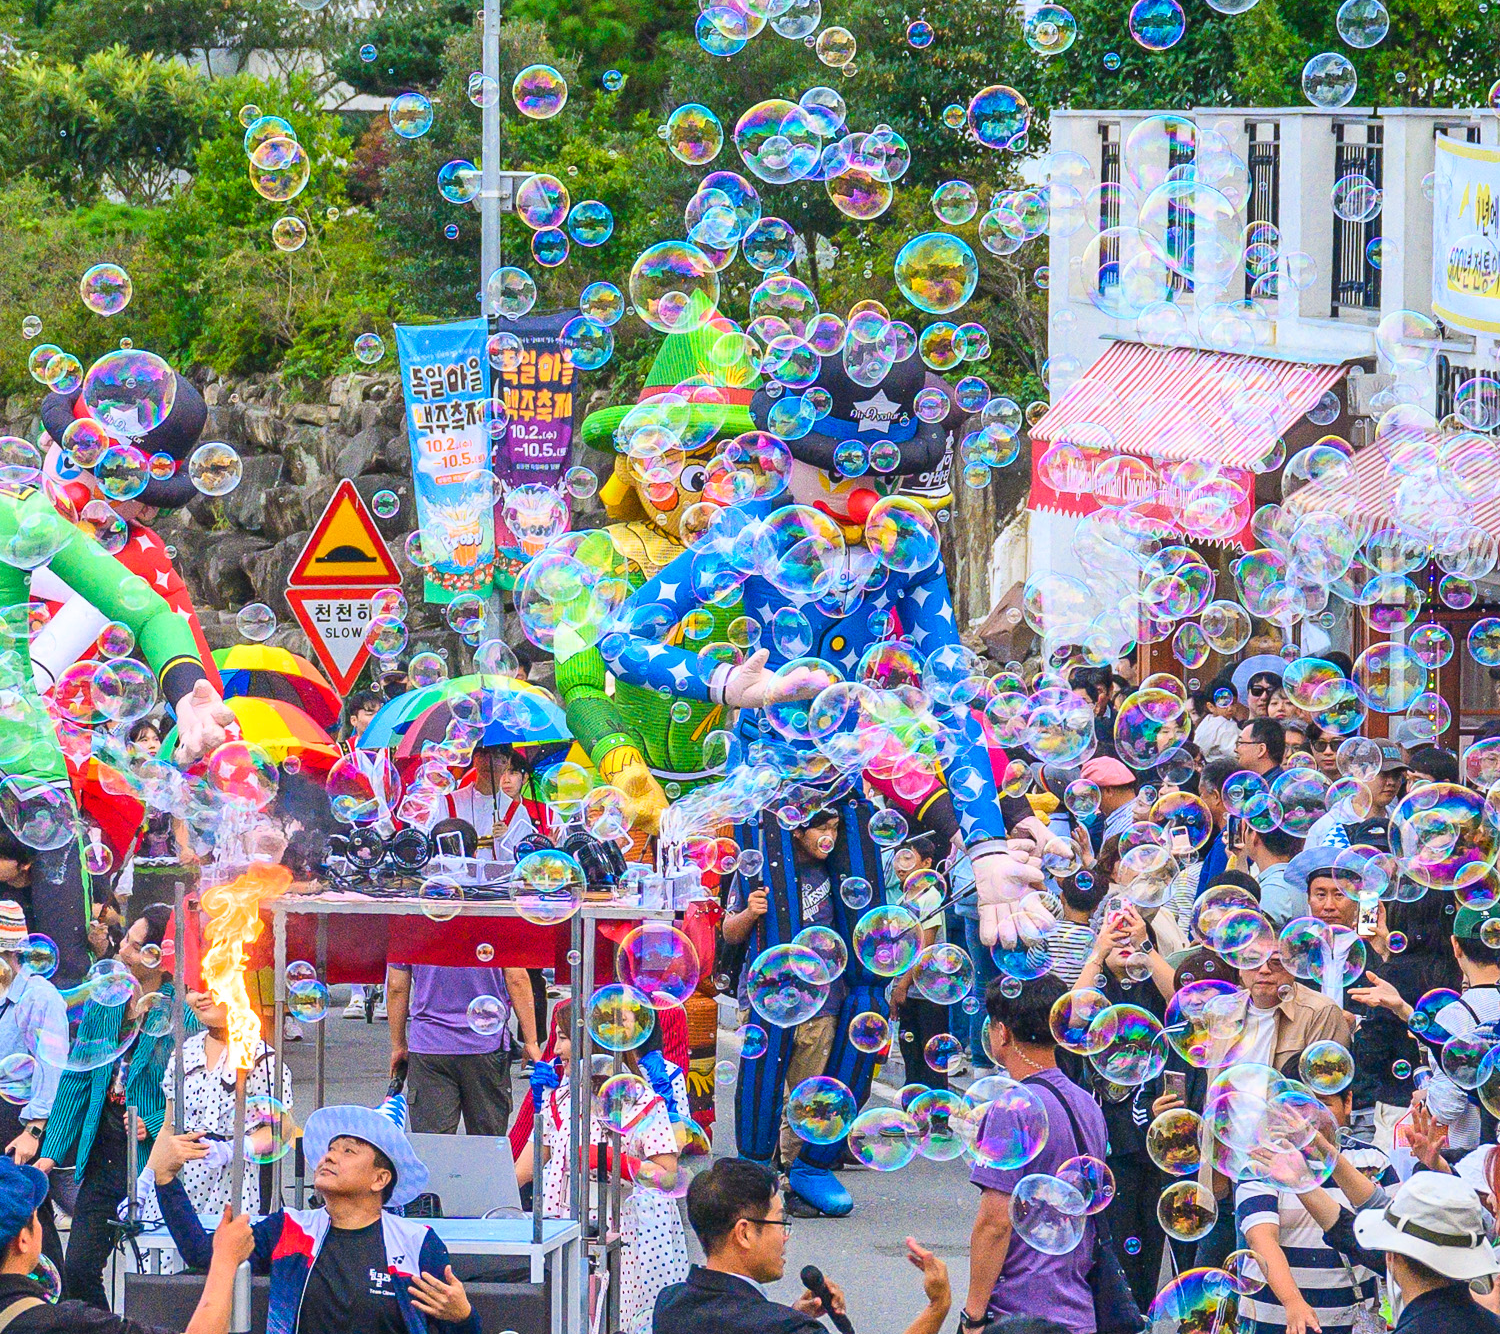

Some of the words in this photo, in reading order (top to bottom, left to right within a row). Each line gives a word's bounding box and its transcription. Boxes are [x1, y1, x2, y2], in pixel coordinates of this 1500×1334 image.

[409, 356, 483, 401] 독일마을
[503, 350, 574, 386] 독일마을
[411, 399, 486, 435] 맥주축제
[503, 387, 573, 422] 맥주축제
[324, 627, 364, 639] SLOW
